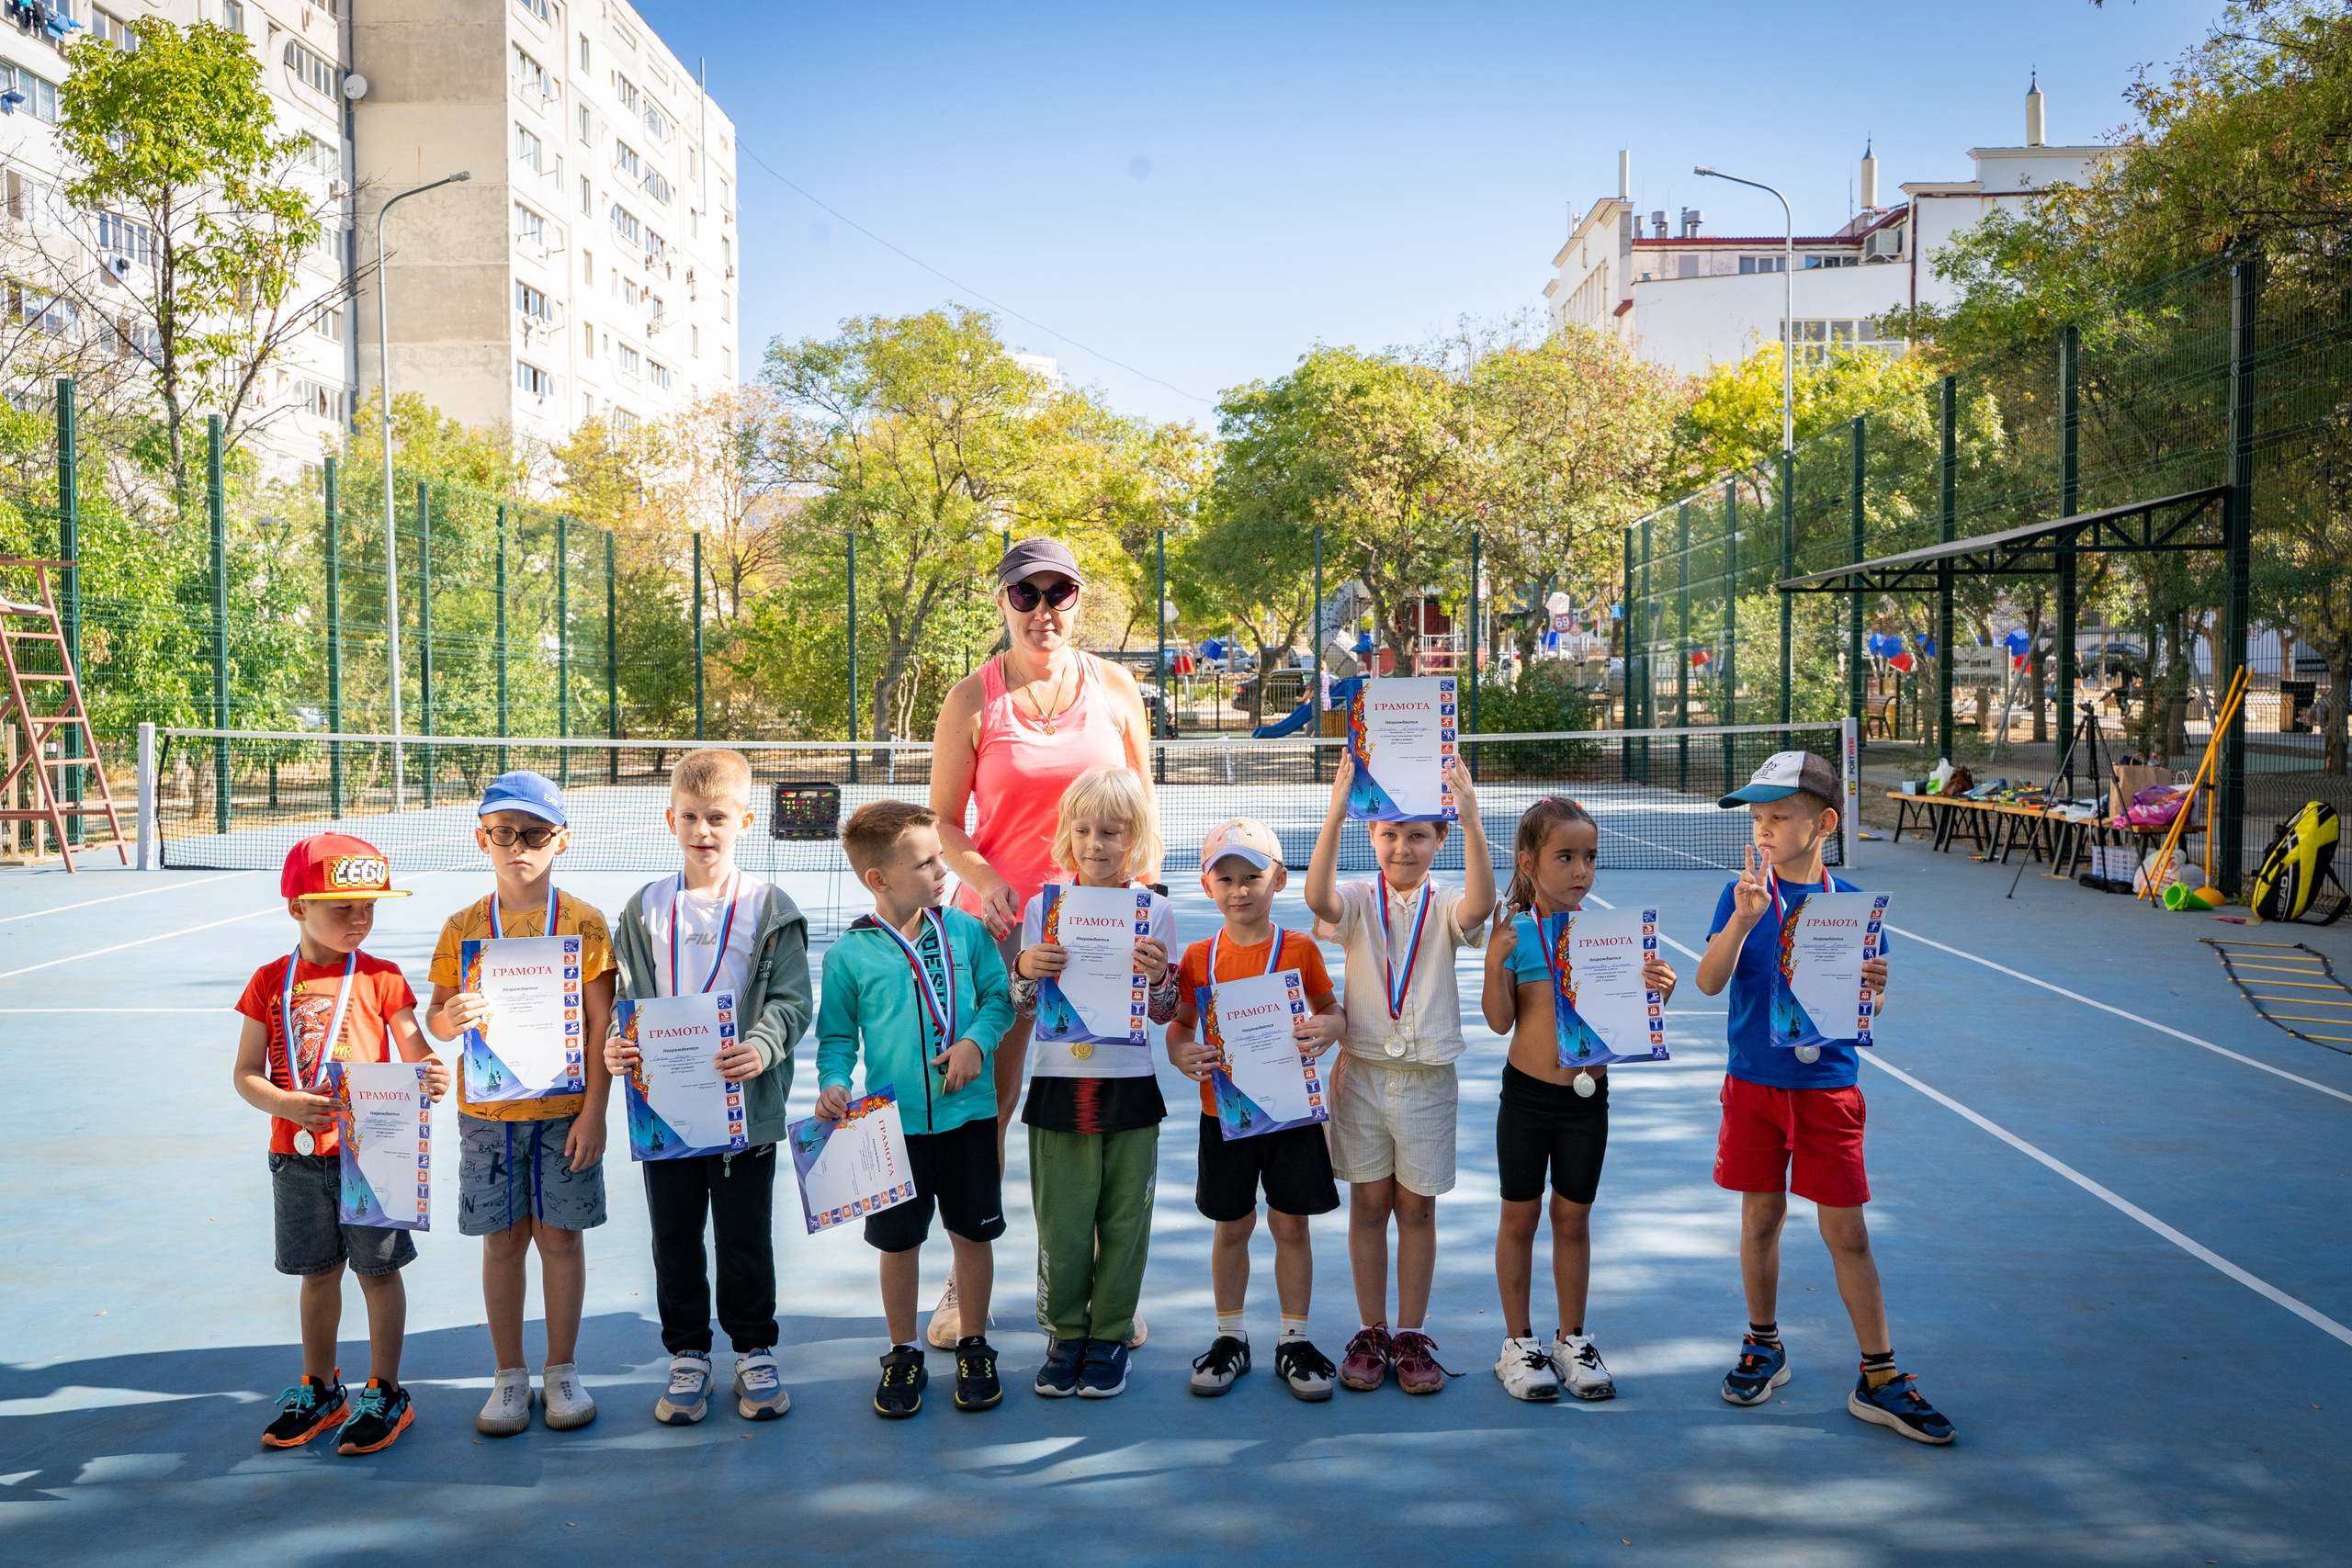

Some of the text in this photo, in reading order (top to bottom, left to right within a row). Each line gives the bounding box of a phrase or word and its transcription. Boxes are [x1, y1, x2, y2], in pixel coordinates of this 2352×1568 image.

[1555, 615, 1570, 628] 69
[1374, 703, 1430, 711] ГРАМОТА
[335, 858, 387, 884] LEGO
[2276, 875, 2289, 919] HEAD
[1069, 917, 1125, 928] ГРАМОТА
[1805, 919, 1859, 927] ГРАМОТА
[1579, 936, 1634, 948] ГРАМОТА
[492, 966, 553, 977] ГРАМОТА
[1227, 1003, 1281, 1021] ГРАМОТА
[649, 1024, 709, 1039] ГРАМОТА
[358, 1090, 412, 1101] ГРАМОТА
[878, 1119, 895, 1177] ГРАМОТА
